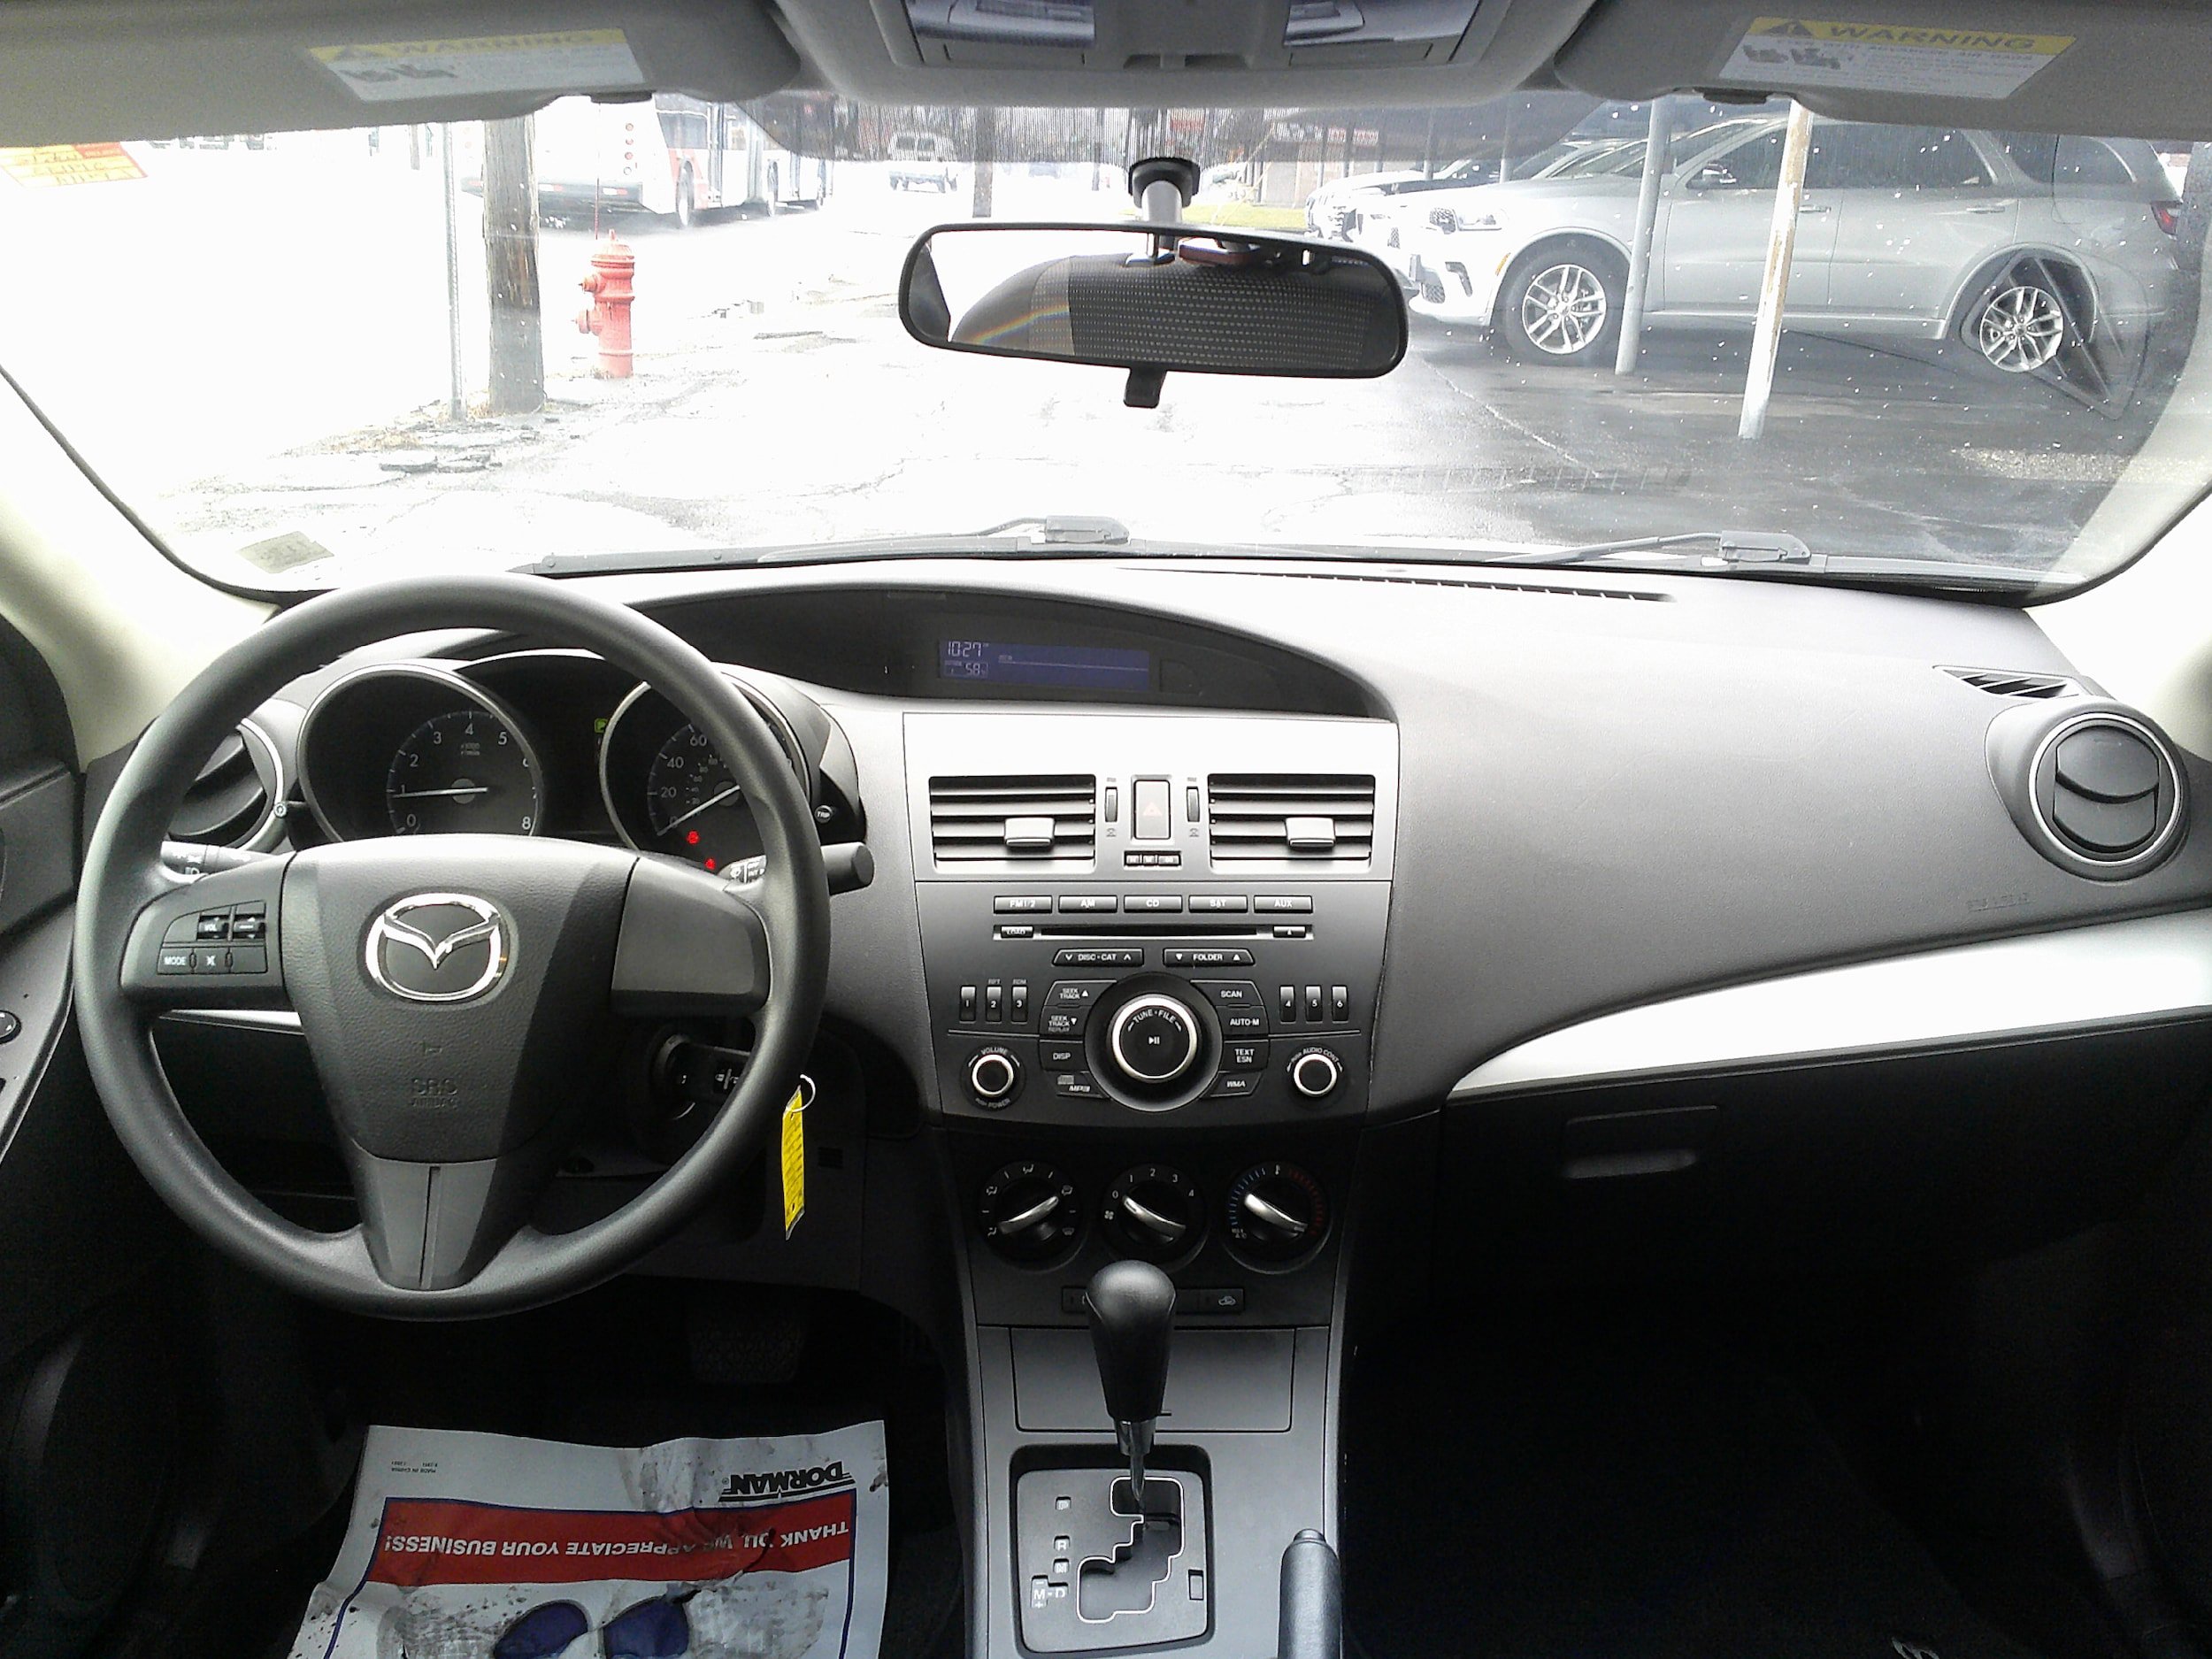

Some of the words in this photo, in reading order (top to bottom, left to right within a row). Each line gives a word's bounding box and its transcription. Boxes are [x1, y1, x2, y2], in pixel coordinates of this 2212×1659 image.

[1830, 26, 2034, 49] WARNING
[465, 723, 474, 735] 4
[433, 731, 442, 744] 3
[497, 731, 508, 745] 5
[689, 734, 707, 746] 60
[410, 753, 419, 768] 2
[666, 756, 685, 769] 40
[660, 786, 677, 798] 20
[406, 813, 416, 827] 0
[522, 816, 532, 830] 8
[1079, 898, 1096, 908] AM
[1145, 898, 1160, 908] CD
[1210, 898, 1227, 908] SAT
[1273, 898, 1293, 908] AUX
[164, 956, 187, 966] MODE
[1220, 989, 1243, 999] SCAN
[1016, 999, 1023, 1008] 3
[980, 1047, 1009, 1056] VOLUME
[1052, 1052, 1071, 1061] DISP
[1323, 1049, 1340, 1063] CONT
[411, 1078, 458, 1096] SRS
[1149, 1168, 1156, 1178] 2
[1171, 1173, 1179, 1183] 3
[1111, 1189, 1119, 1199] 0
[1188, 1188, 1195, 1198] 4
[729, 1460, 845, 1495] DORMAN
[779, 1521, 849, 1548] THANK
[384, 1534, 496, 1556] BUSINESS!
[501, 1540, 559, 1556] YOUR
[1057, 1540, 1067, 1551] R
[1056, 1563, 1067, 1574] N
